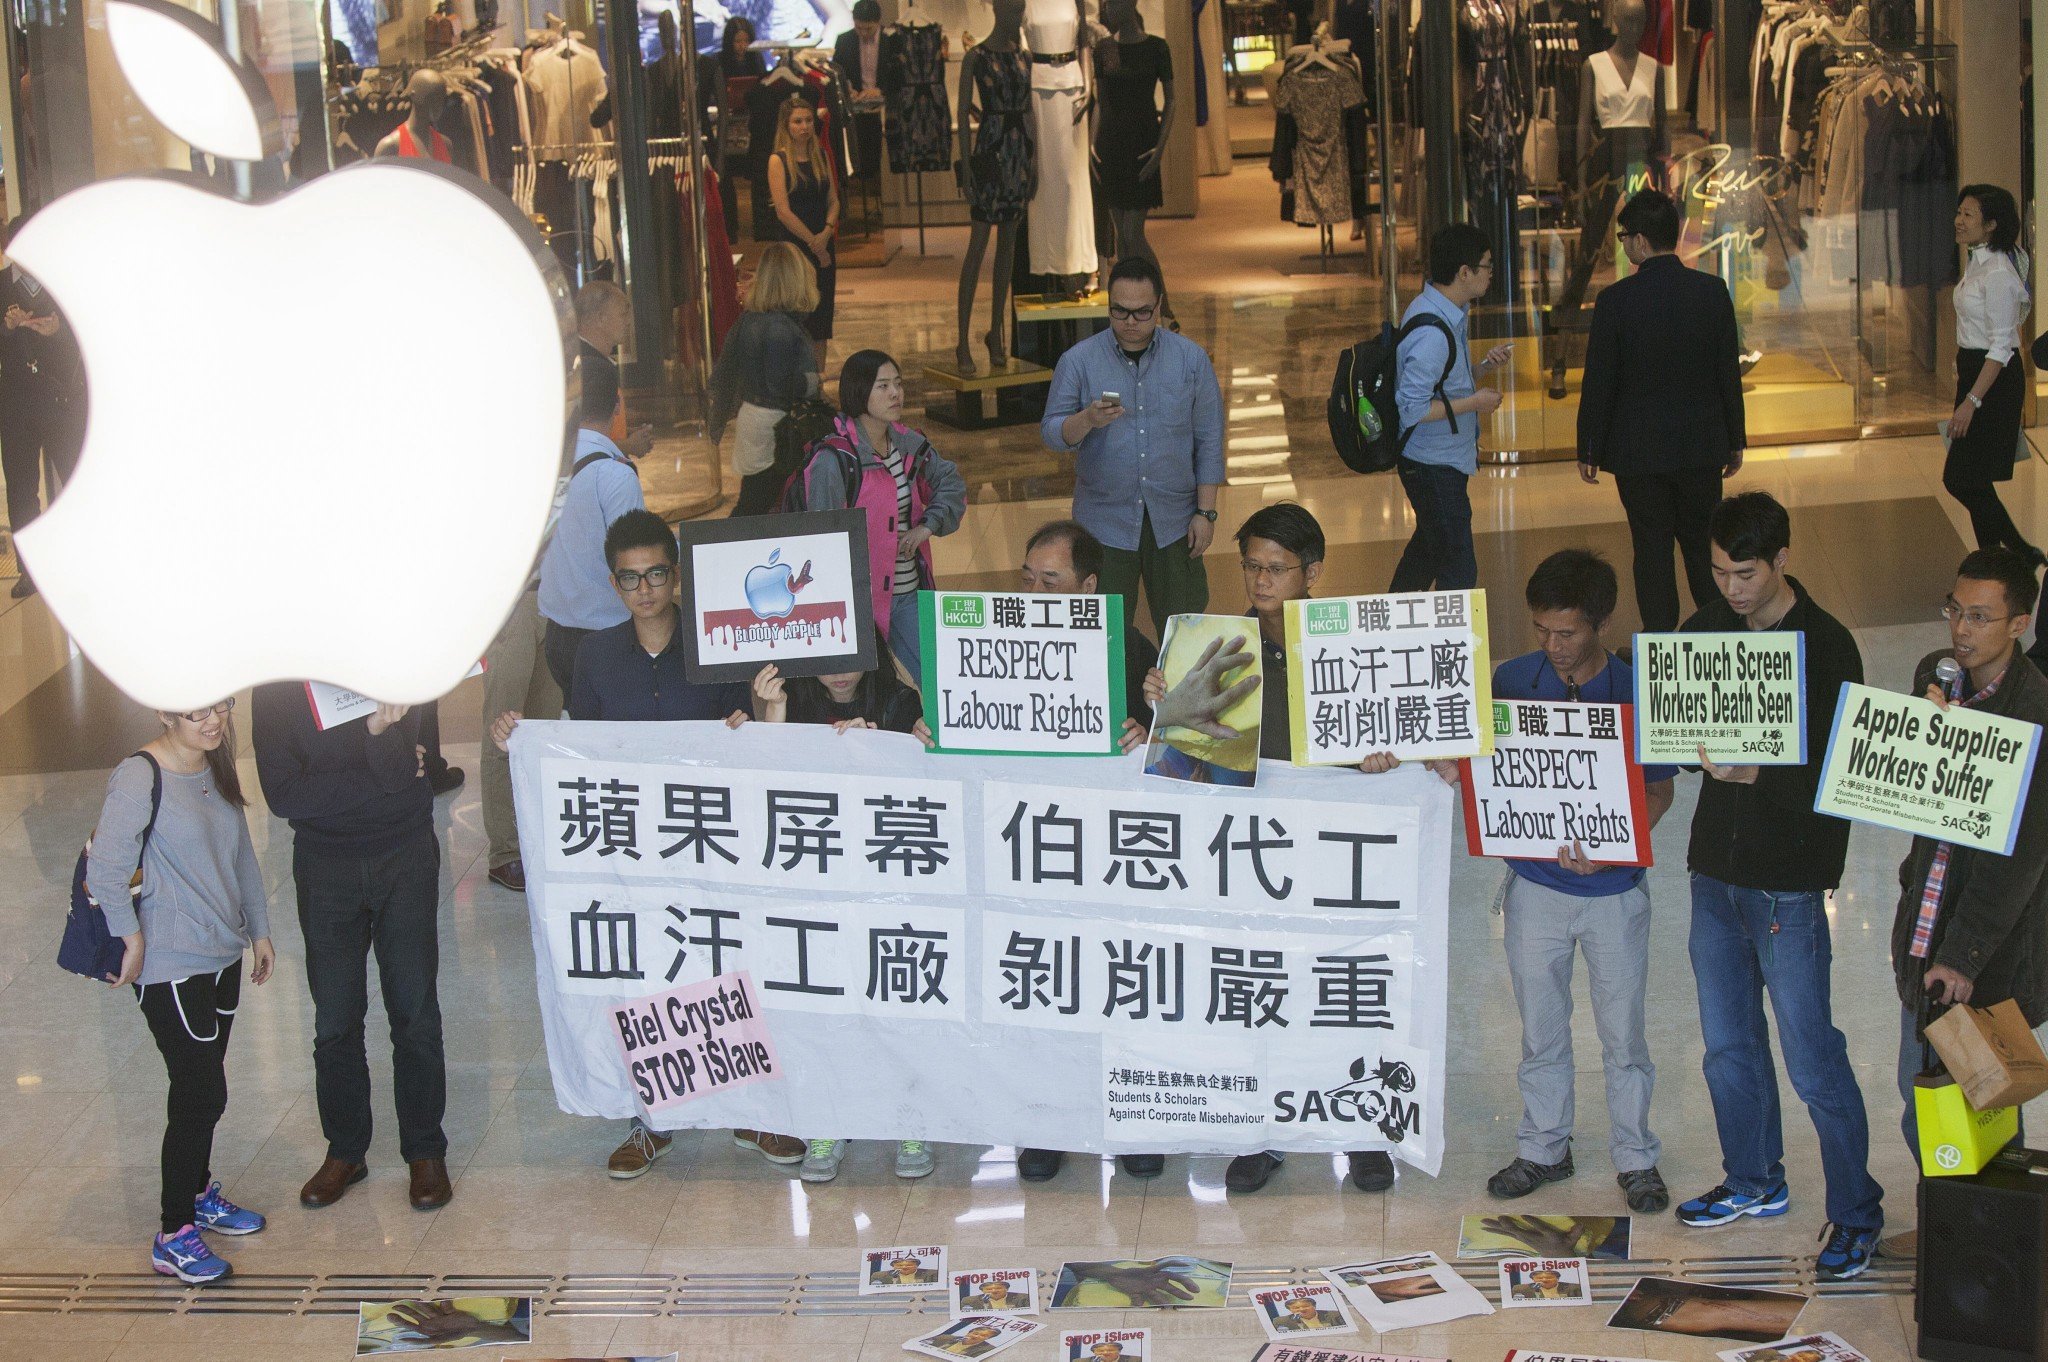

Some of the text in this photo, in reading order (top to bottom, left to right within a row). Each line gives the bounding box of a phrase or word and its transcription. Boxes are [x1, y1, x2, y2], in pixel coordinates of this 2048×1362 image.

[945, 612, 982, 624] HKCTU
[951, 599, 976, 612] 工盟
[992, 597, 1102, 630] 職工盟
[1315, 605, 1341, 619] 工盟
[1356, 594, 1467, 633] 職工盟
[735, 622, 821, 643] BLOODY APPLE
[1310, 618, 1347, 632] HKCTU
[958, 637, 1077, 682] RESPECT
[1310, 638, 1471, 695] 血汗工廠
[1648, 641, 1792, 681] Biel Touch Screen
[942, 689, 1103, 740] Labour Rights
[1649, 681, 1793, 724] Workers Death Seen
[1312, 691, 1474, 749] 剝削嚴重
[1517, 704, 1619, 740] 職工盟
[1852, 697, 2022, 764] Apple Supplier
[1650, 746, 1671, 754] Against
[1742, 741, 1785, 753] SACOM
[1492, 748, 1598, 790] RESPECT
[1847, 737, 1994, 805] Workers Suffer
[1832, 795, 1937, 826] Against Corporate Misbehaviour
[1835, 788, 1864, 802] Students
[1871, 796, 1900, 809] Scholars
[1837, 778, 1945, 811] 大學師生監察無良企業行動
[1480, 799, 1630, 849] Labour Rights
[1941, 815, 1991, 837] SACOM
[558, 776, 1401, 910] 蘋果屏幕 伯恩代工
[567, 899, 1396, 1031] 血汗工廠 剝削嚴重
[615, 978, 754, 1051] Biel Crystal
[631, 1037, 772, 1106] STOP iSlave
[1108, 1067, 1258, 1093] 大學師生監察無良企業行動
[1108, 1090, 1207, 1106] Students & Scholars
[1273, 1090, 1421, 1136] SACOM
[1109, 1108, 1265, 1126] Against Corporate Misbehaviour
[954, 1270, 1031, 1286] STOP iSlave
[1504, 1260, 1580, 1273] STOP iSlave
[1255, 1286, 1332, 1305] STOP iSlave
[1065, 1331, 1145, 1347] STOP iSlave
